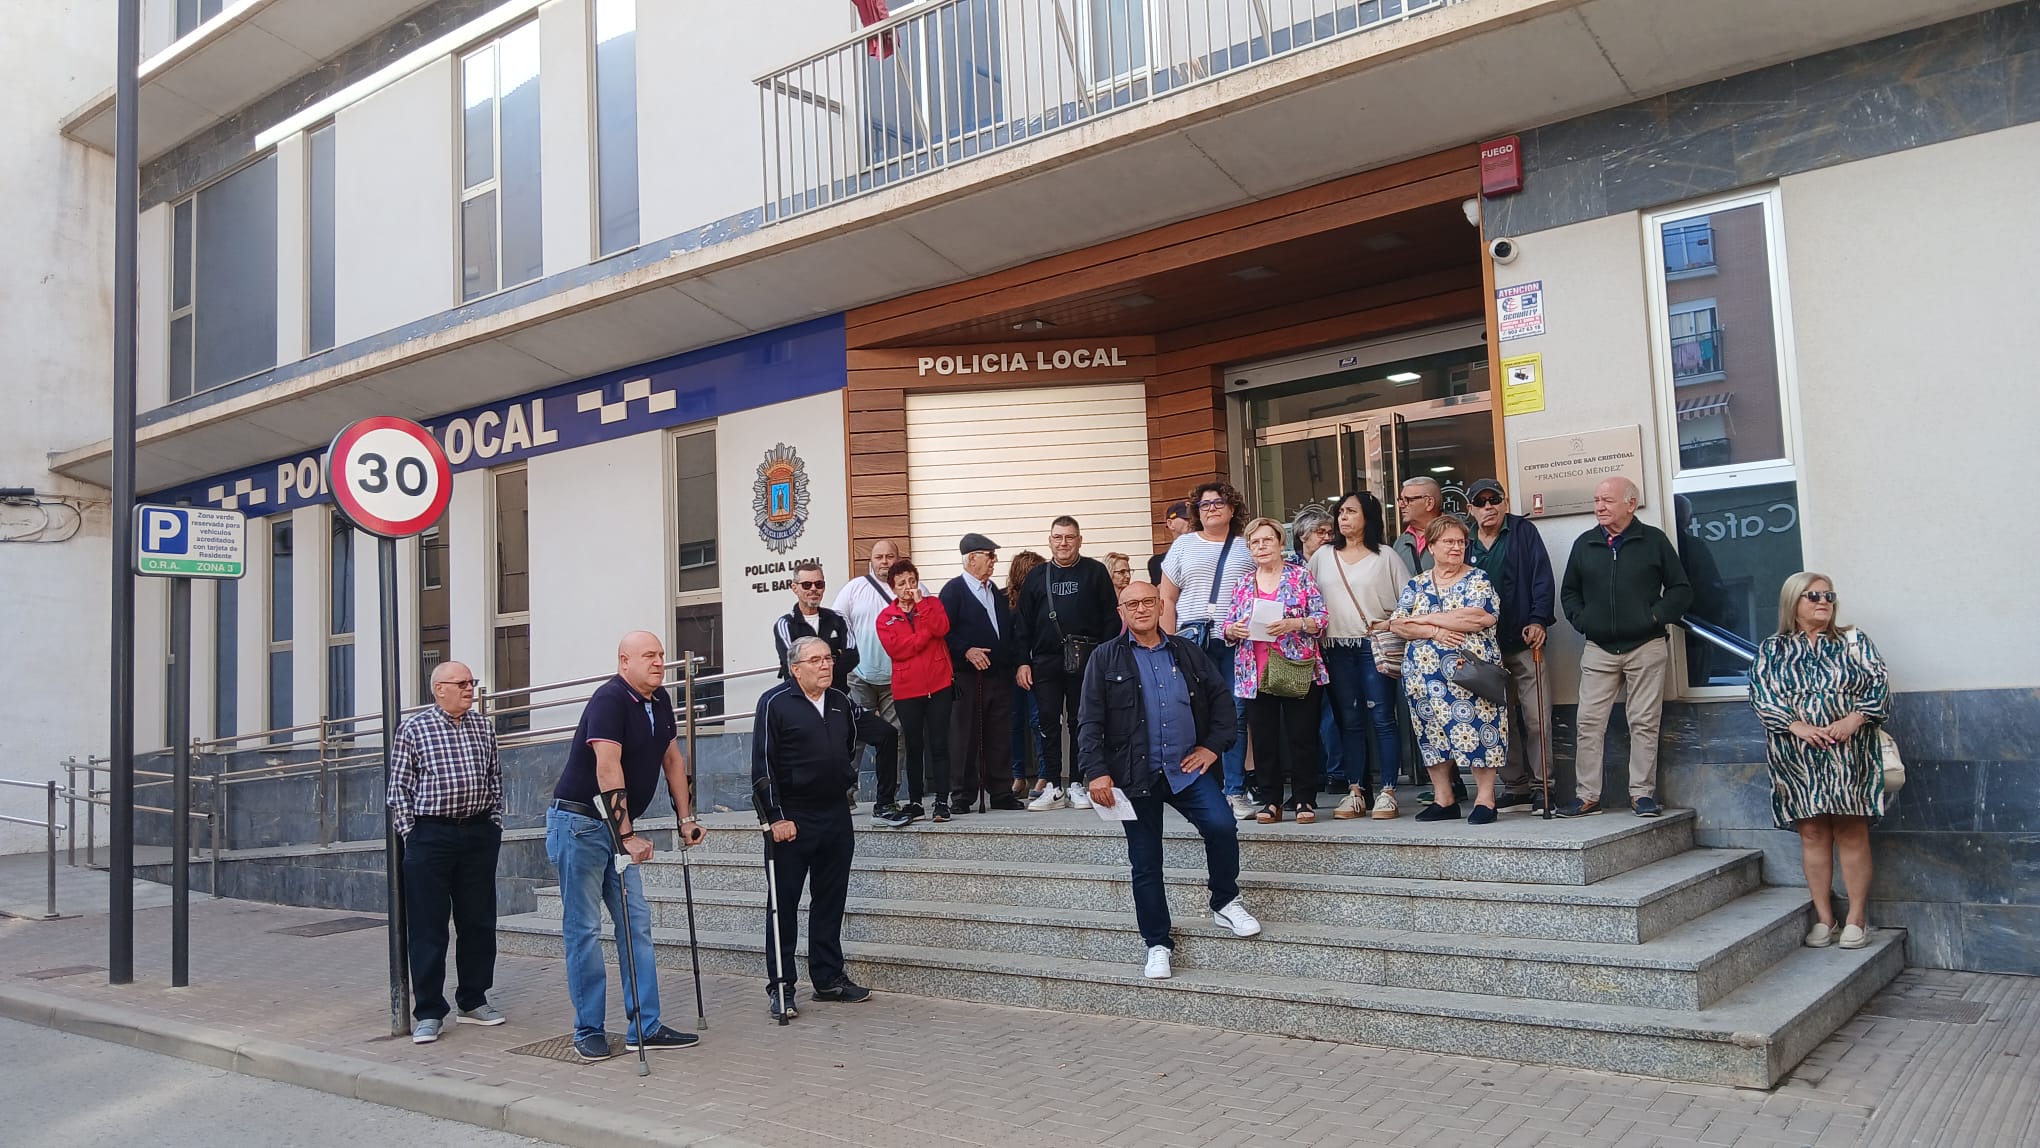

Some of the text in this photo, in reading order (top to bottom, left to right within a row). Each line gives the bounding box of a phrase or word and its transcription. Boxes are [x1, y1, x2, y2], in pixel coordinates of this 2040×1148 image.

[1481, 144, 1513, 159] FUEGO
[918, 347, 1127, 376] POLICIA LOCAL
[430, 398, 558, 465] OCAL
[357, 452, 428, 497] 30
[1524, 463, 1549, 471] CENTRO
[196, 536, 235, 544] acreditados
[207, 544, 228, 552] tarjeta
[149, 560, 234, 572] O.R.A. ZONA 3
[745, 561, 786, 577] POLICIA
